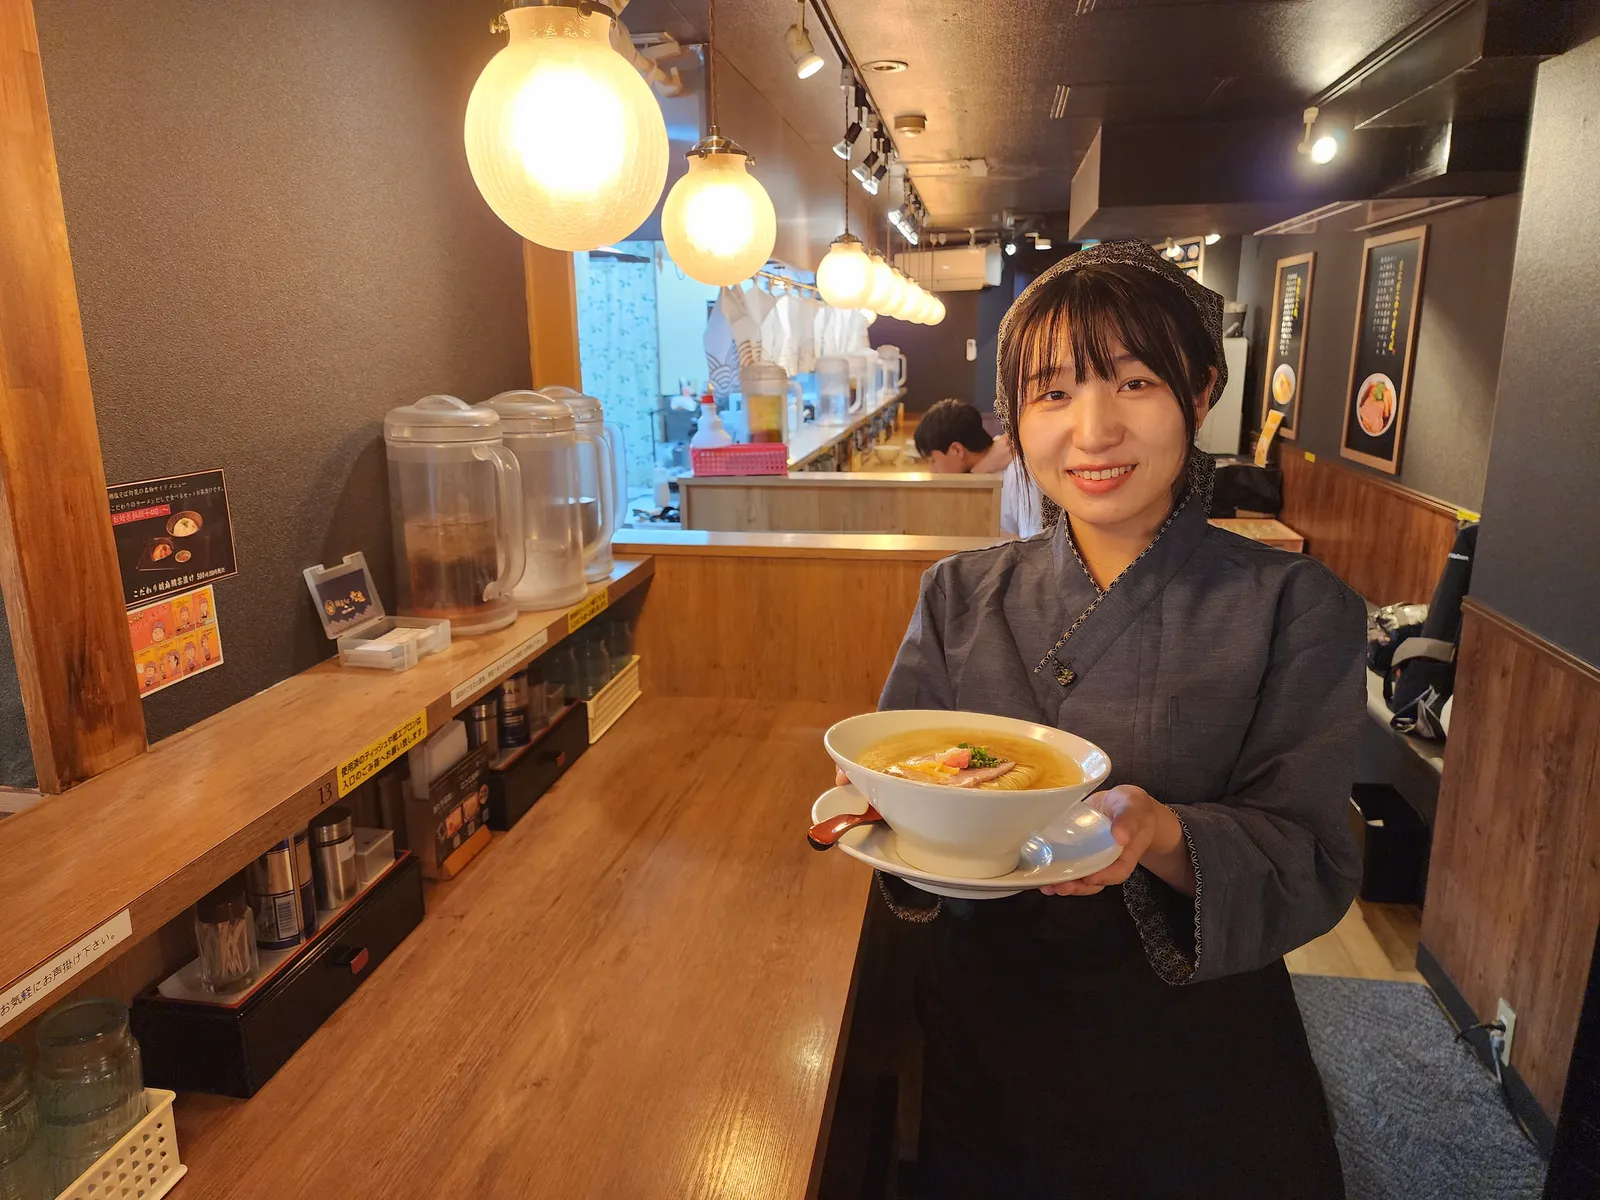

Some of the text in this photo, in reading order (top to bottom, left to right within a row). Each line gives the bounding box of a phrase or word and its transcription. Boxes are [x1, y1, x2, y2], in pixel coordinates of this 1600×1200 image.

[317, 782, 332, 806] 13
[0, 934, 115, 1016] お気軽にお声掛け下さい。
